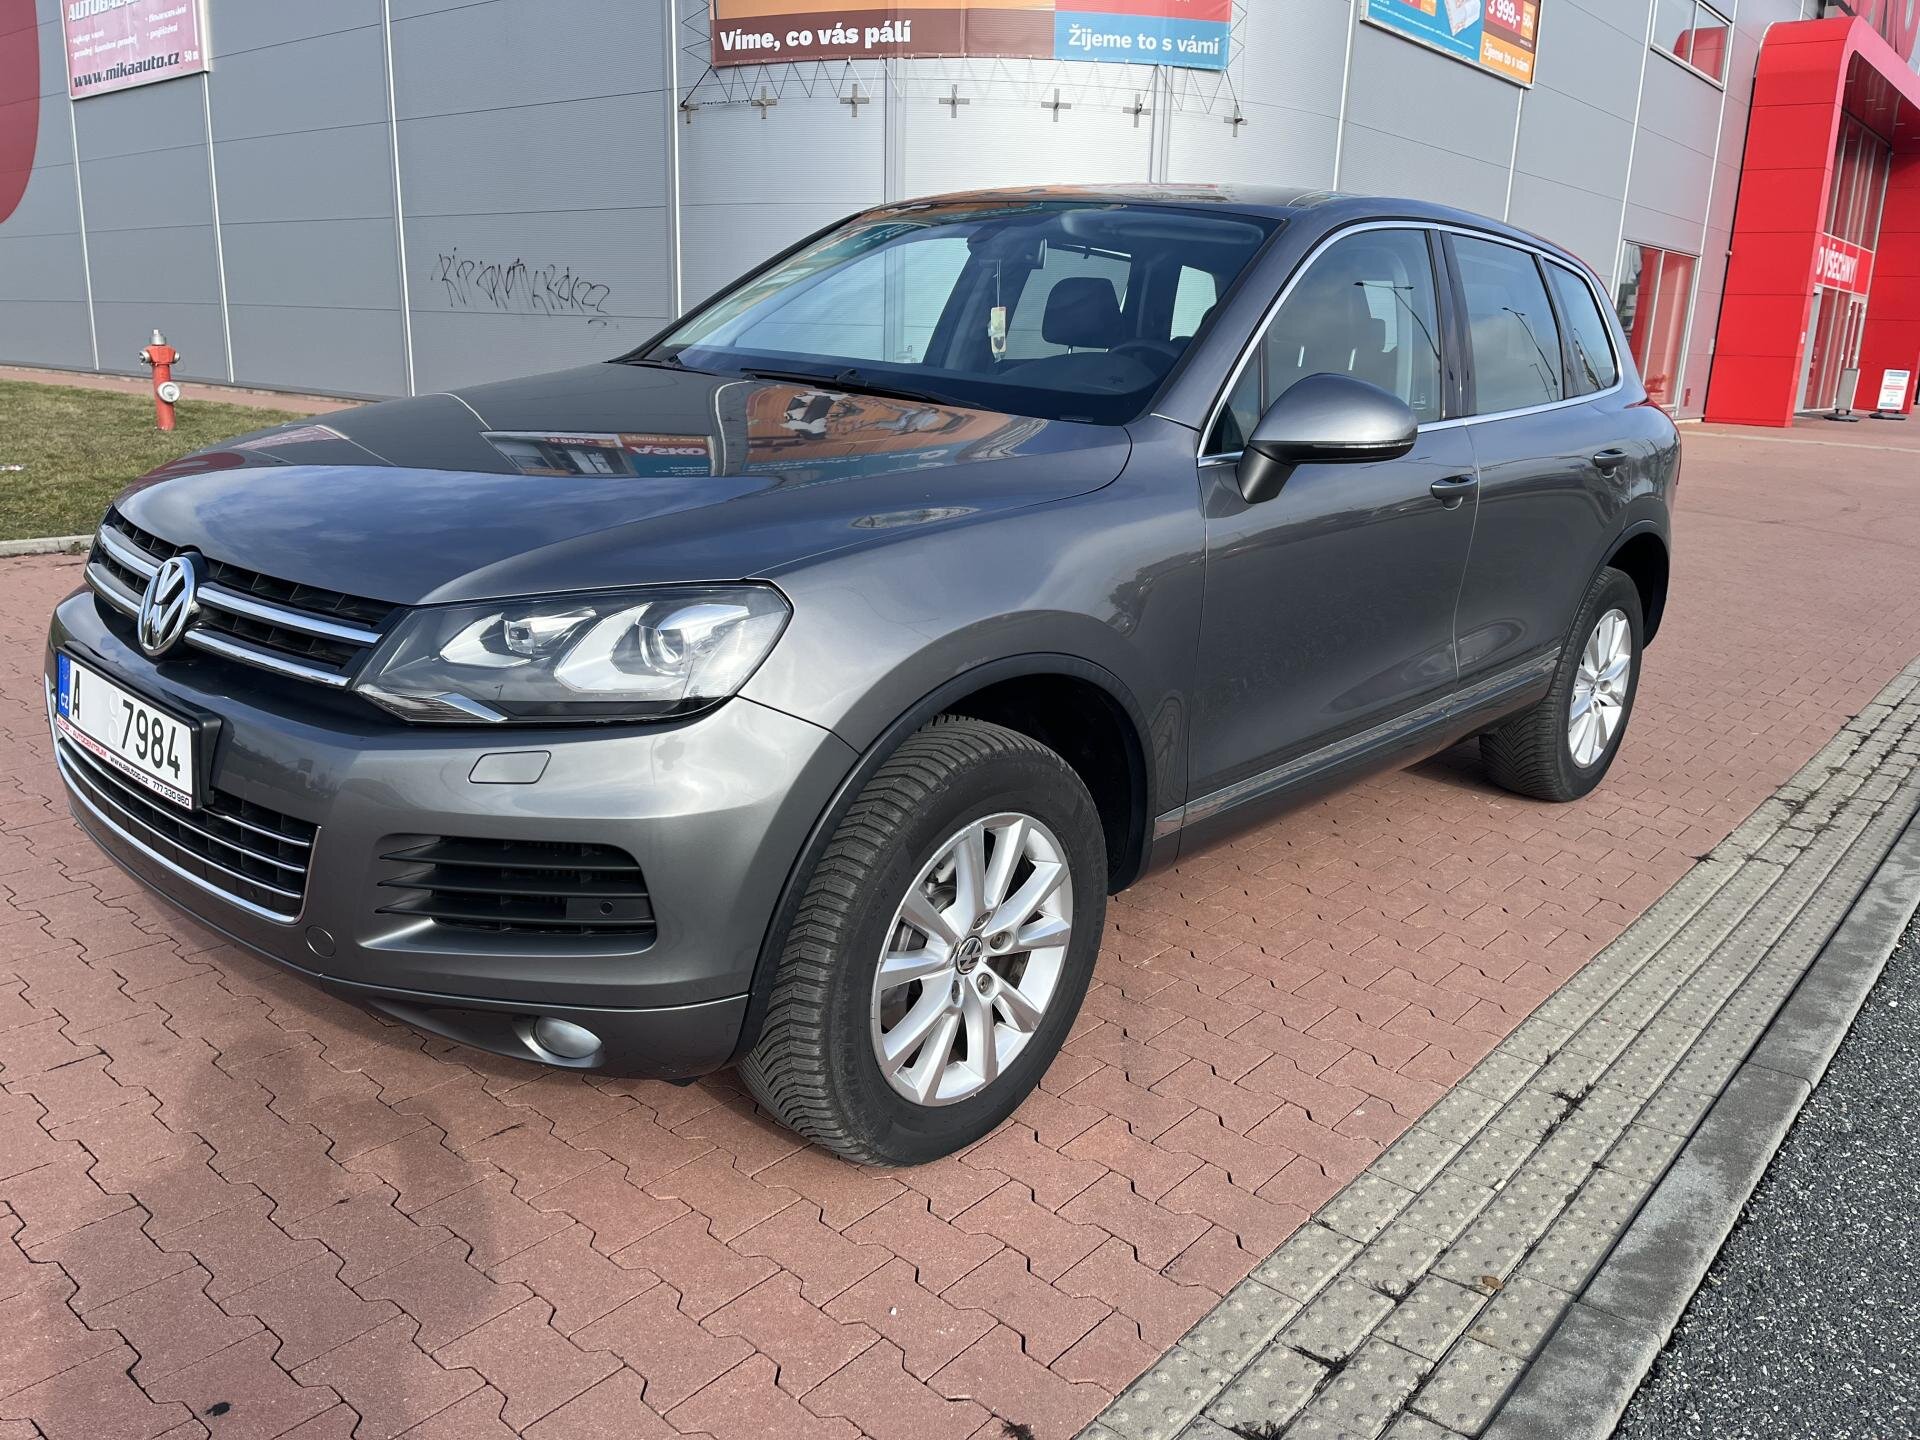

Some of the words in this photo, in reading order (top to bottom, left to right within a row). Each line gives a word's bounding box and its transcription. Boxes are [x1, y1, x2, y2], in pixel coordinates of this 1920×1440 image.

[719, 28, 781, 51] Víme,
[786, 30, 813, 46] co
[818, 22, 859, 45] vás
[864, 20, 912, 49] pálí
[1068, 24, 1133, 51] Žijeme
[1137, 33, 1156, 50] to
[1162, 38, 1172, 52] s
[1177, 35, 1219, 55] vámi
[73, 51, 180, 88] www.mikaauto.cz
[1824, 243, 1858, 284] VŠECHNY
[60, 692, 70, 710] CZ
[121, 699, 181, 780] 7984
[152, 780, 164, 793] 777
